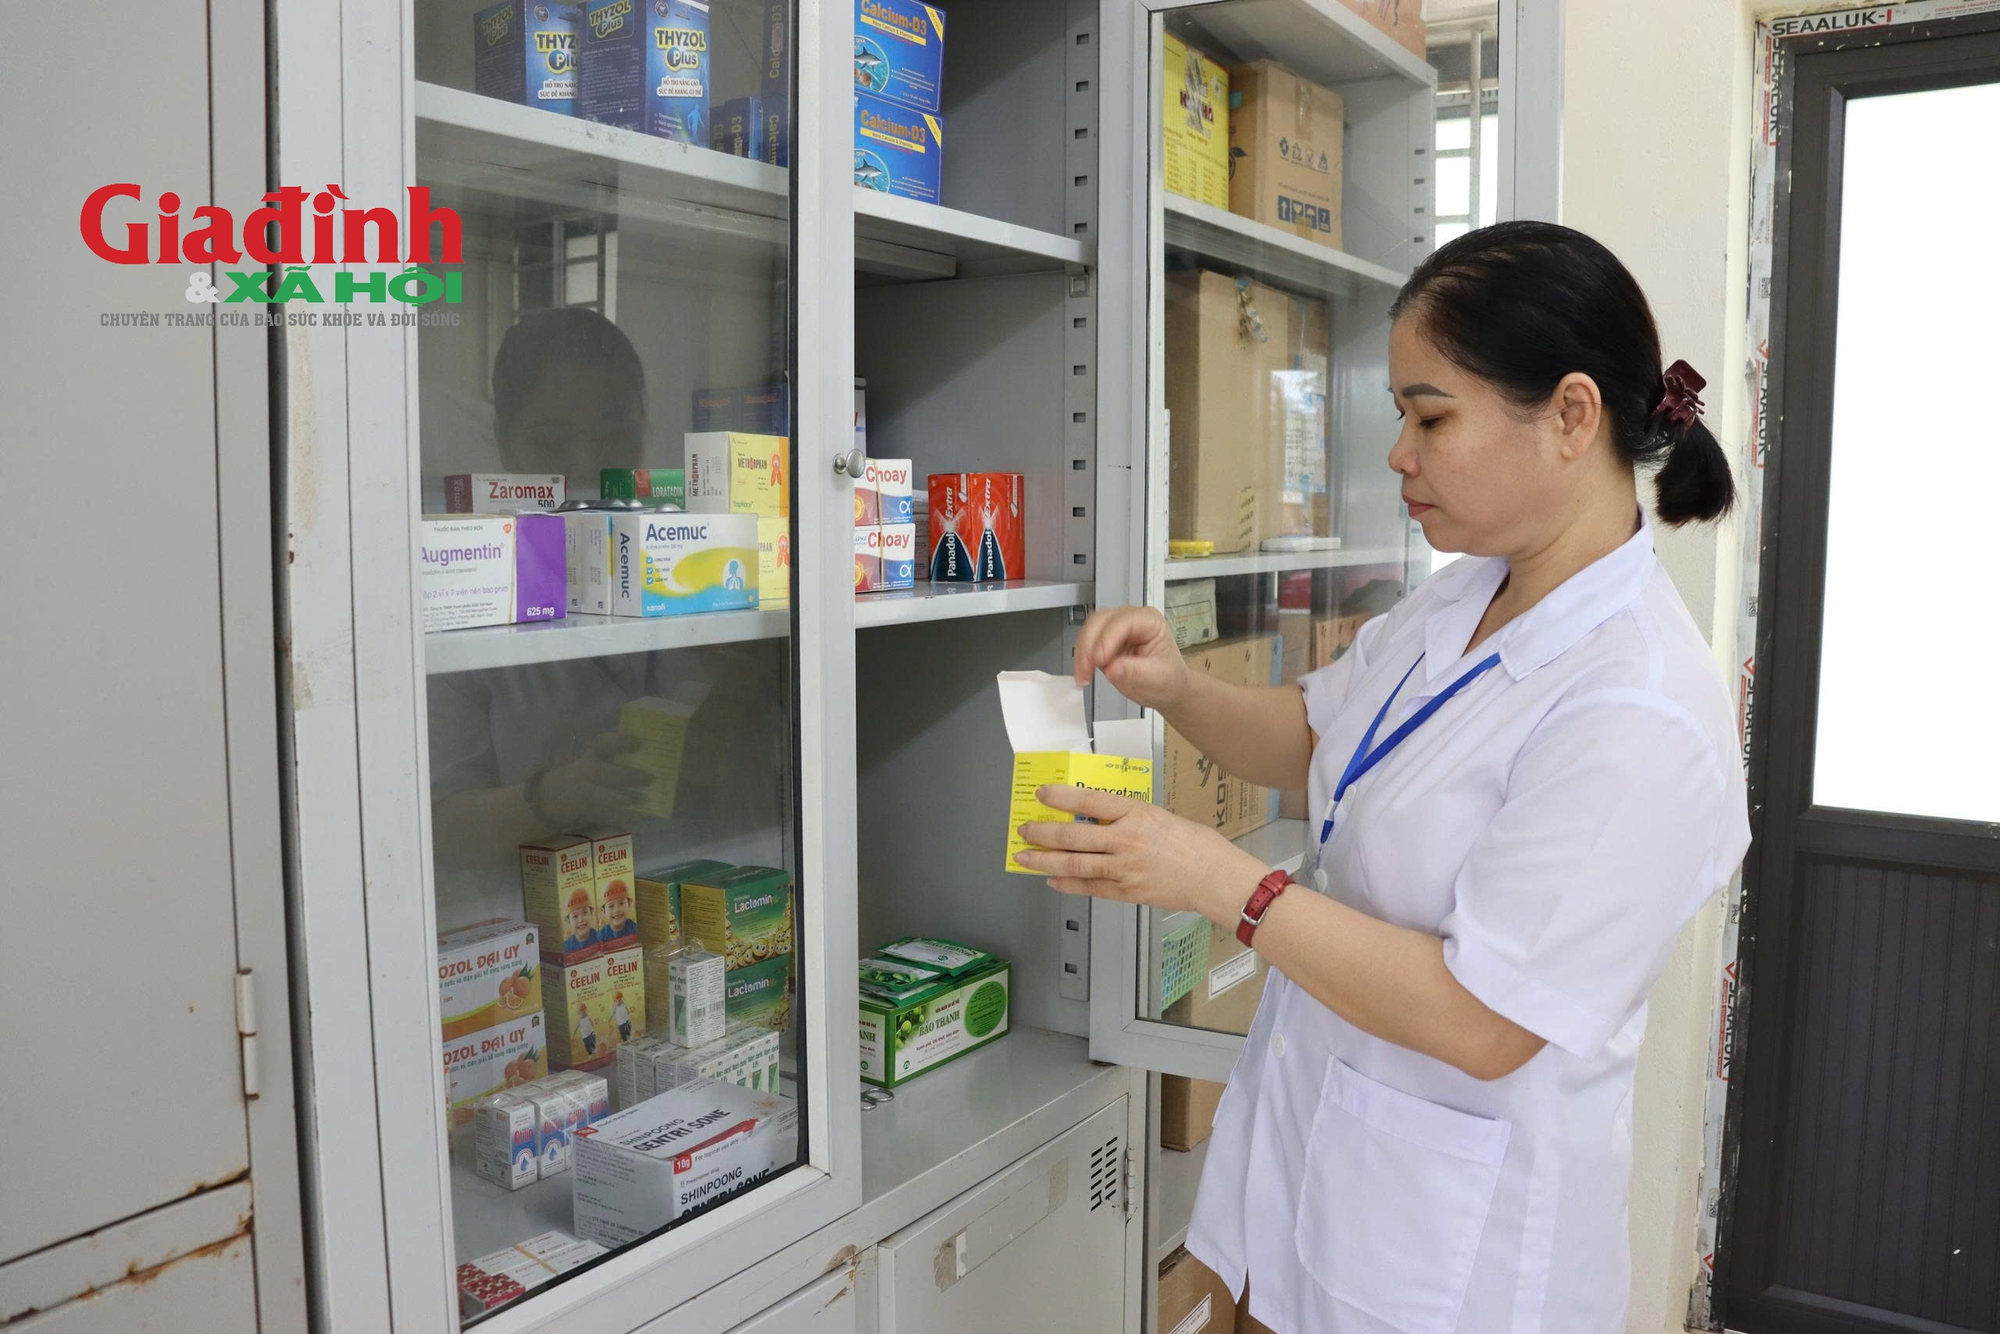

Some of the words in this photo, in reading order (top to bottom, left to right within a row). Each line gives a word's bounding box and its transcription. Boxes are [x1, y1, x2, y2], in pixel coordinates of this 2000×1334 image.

[590, 1, 631, 24] THYZOL
[861, 0, 927, 35] Calcium-D3
[597, 18, 623, 36] Plus
[536, 33, 577, 49] THYZ
[656, 29, 705, 47] THYZOL
[667, 48, 697, 67] Plus
[861, 109, 926, 143] Calcium-D3
[489, 482, 554, 499] Zaromax
[652, 485, 684, 498] LORATADIN
[946, 487, 954, 519] Extra
[646, 524, 707, 542] Acemuc
[868, 532, 910, 548] Choay
[422, 543, 501, 566] Augmentin
[946, 534, 956, 577] Panadol
[985, 531, 994, 578] Panadol
[620, 533, 631, 599] Acemuc
[527, 607, 541, 616] 625
[542, 607, 554, 616] mg
[1076, 782, 1150, 802] acetamol
[526, 854, 549, 866] CEELIN
[561, 857, 587, 874] CEELIN
[598, 849, 627, 864] CEELIN
[734, 893, 773, 914] Lactomin
[477, 950, 500, 968] ĐẠI
[607, 961, 637, 977] CEELIN
[570, 972, 600, 989] CEELIN
[728, 977, 770, 998] Lactomin
[919, 1019, 935, 1037] BẢO
[936, 1010, 960, 1030] THANH
[481, 1035, 505, 1053] ĐẠI
[859, 1030, 877, 1043] ANH
[619, 1119, 685, 1146] SHINPOONG
[634, 1109, 731, 1152] GENTRI-SONE
[695, 1154, 703, 1162] For
[721, 1143, 729, 1151] use
[730, 1139, 739, 1148] only
[677, 1158, 690, 1170] 10g
[681, 1166, 742, 1205] SHINPOONG
